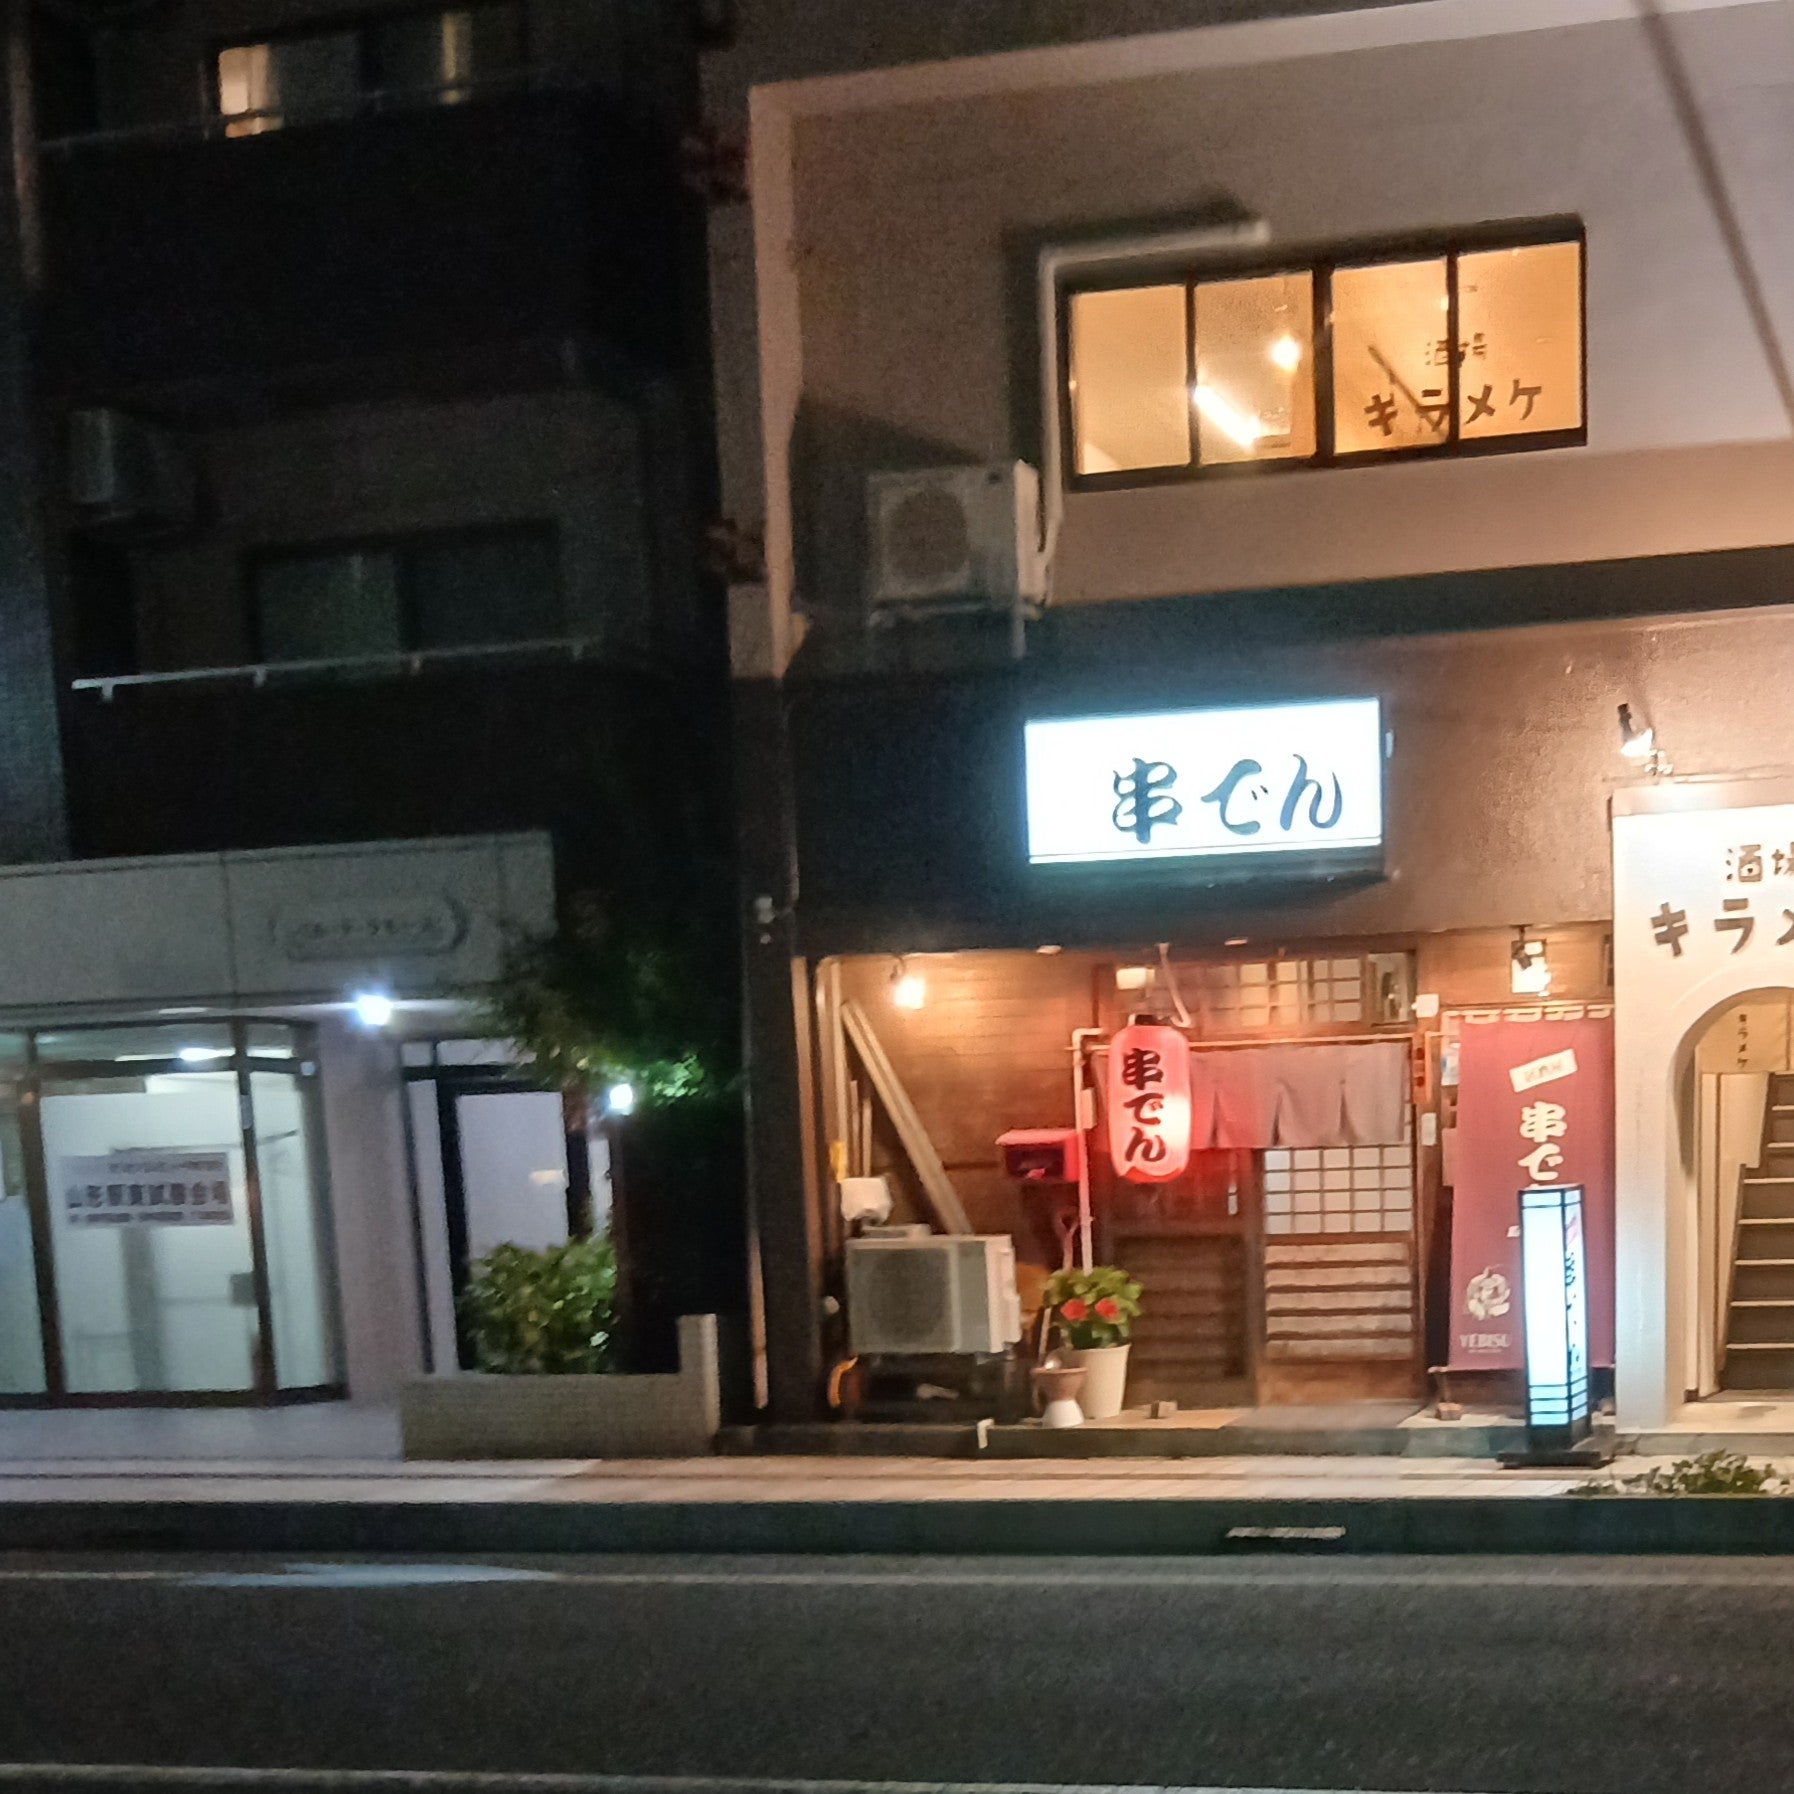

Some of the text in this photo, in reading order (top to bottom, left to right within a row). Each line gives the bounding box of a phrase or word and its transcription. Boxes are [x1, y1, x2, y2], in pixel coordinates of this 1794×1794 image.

[1112, 753, 1343, 844] 串でん
[1121, 1047, 1167, 1163] 串でん
[1517, 1100, 1568, 1189] 串で
